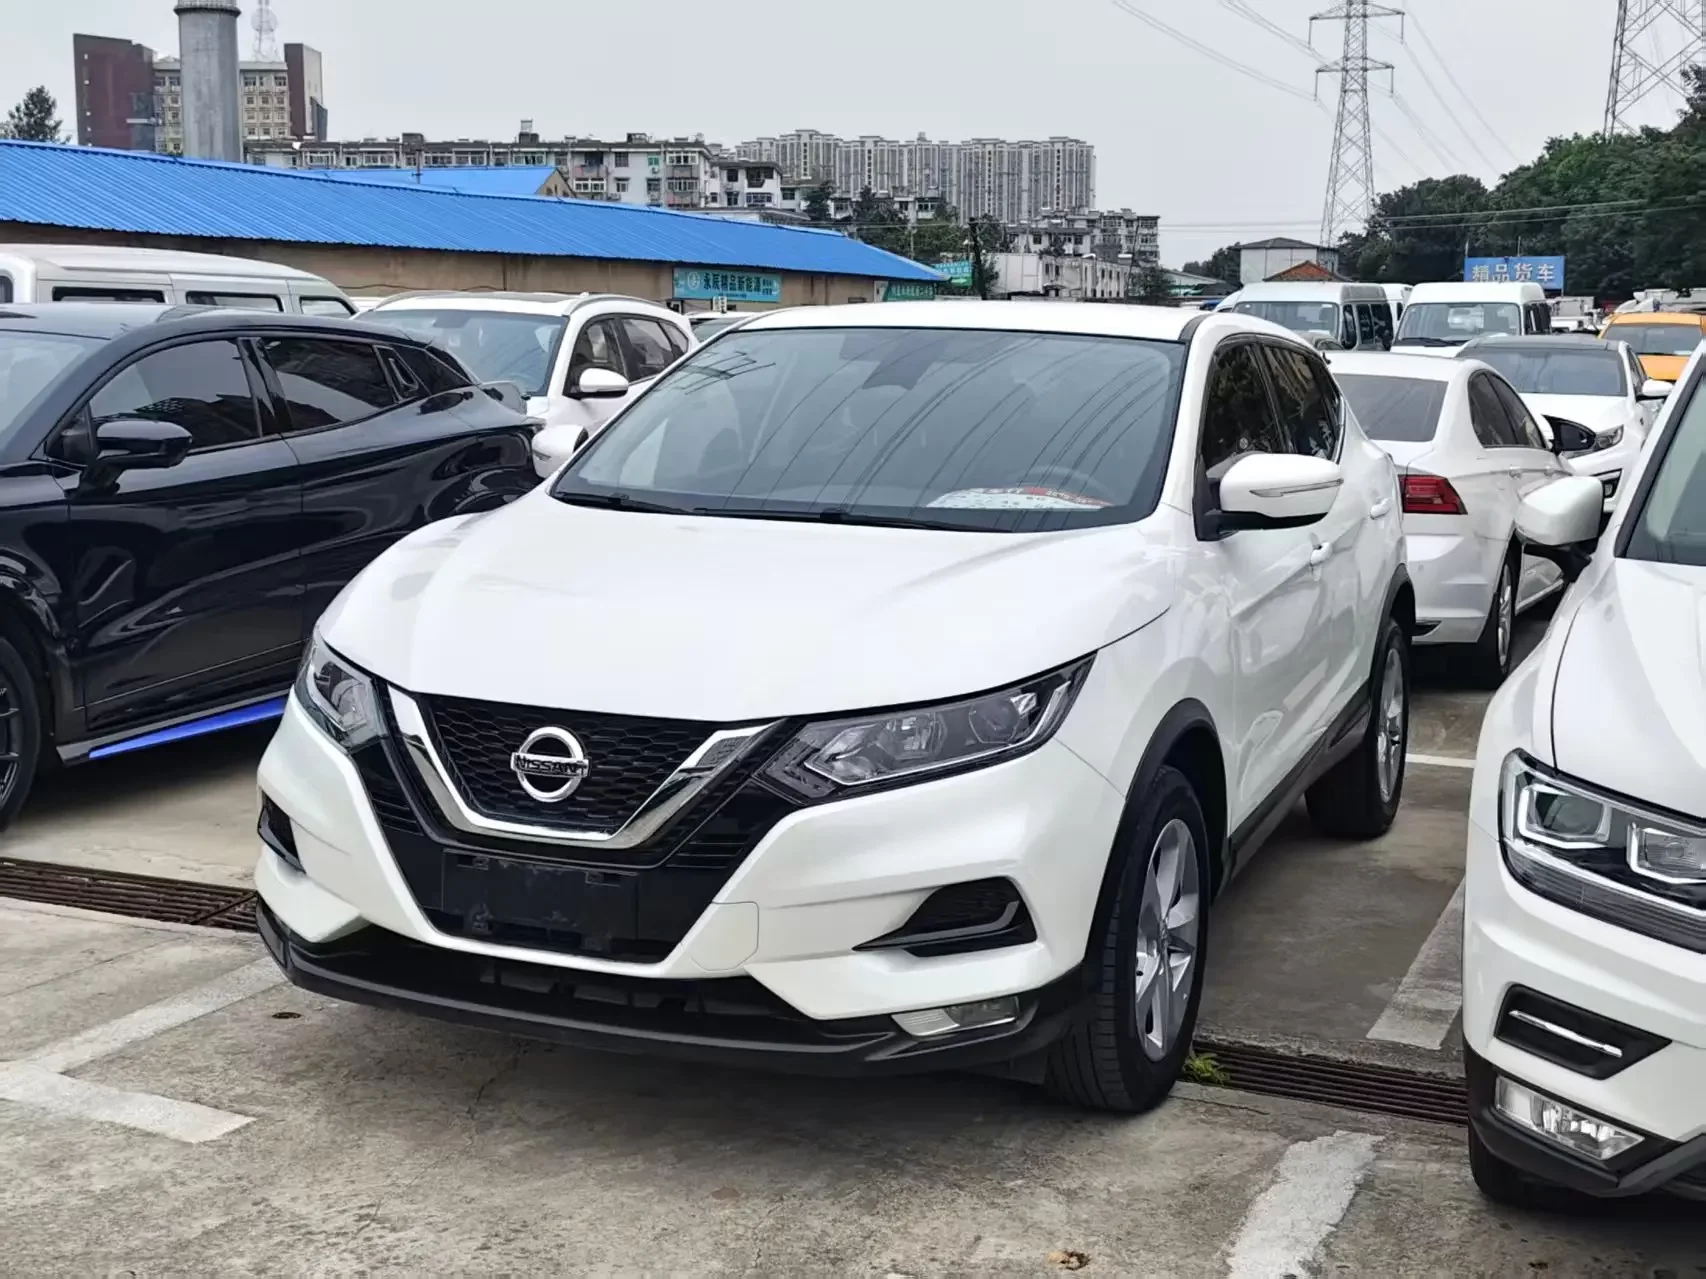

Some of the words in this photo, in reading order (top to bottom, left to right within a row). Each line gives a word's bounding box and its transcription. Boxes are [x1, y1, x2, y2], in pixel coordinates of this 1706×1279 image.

[1472, 263, 1555, 282] 精品货车
[514, 754, 581, 776] NISSAN
